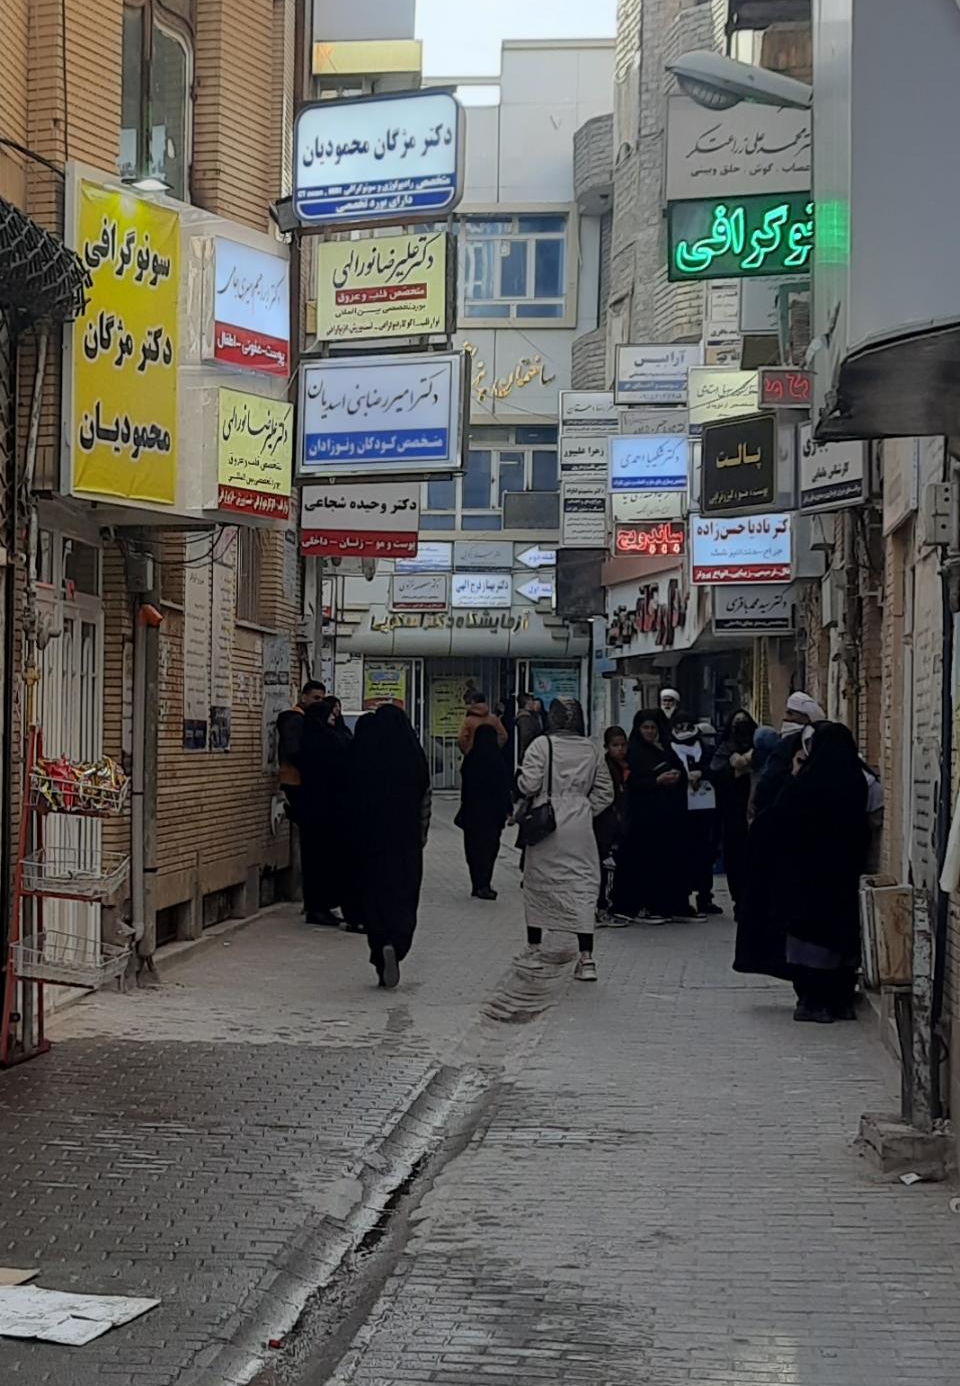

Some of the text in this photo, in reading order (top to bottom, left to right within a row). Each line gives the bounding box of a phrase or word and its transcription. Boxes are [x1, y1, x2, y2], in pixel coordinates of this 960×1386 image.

[302, 123, 453, 167] دکتر مژگان محمودیان
[720, 165, 740, 176] حلق
[750, 163, 773, 176] گوش
[675, 203, 814, 272] نوگرافی
[85, 218, 171, 286] سونوگرافی
[399, 233, 441, 283] دکتر
[377, 241, 419, 283] علیرضا
[337, 292, 361, 303] عروق
[371, 289, 387, 300] قلب
[390, 286, 424, 300] متخصص
[84, 311, 172, 371] دکتر مژگان
[408, 368, 446, 412] دکتر
[80, 402, 171, 459] محمودیان
[357, 435, 397, 454] کودکان
[397, 435, 443, 453] متخصص
[715, 441, 762, 469] پالت
[305, 496, 417, 514] دکتر وحیده شجاعی
[773, 518, 788, 539] کتر
[302, 535, 328, 548] داخلی
[339, 537, 364, 549] زنان
[375, 541, 386, 550] مو
[393, 540, 416, 551] پوست
[455, 609, 529, 633] آزمایشگاه
